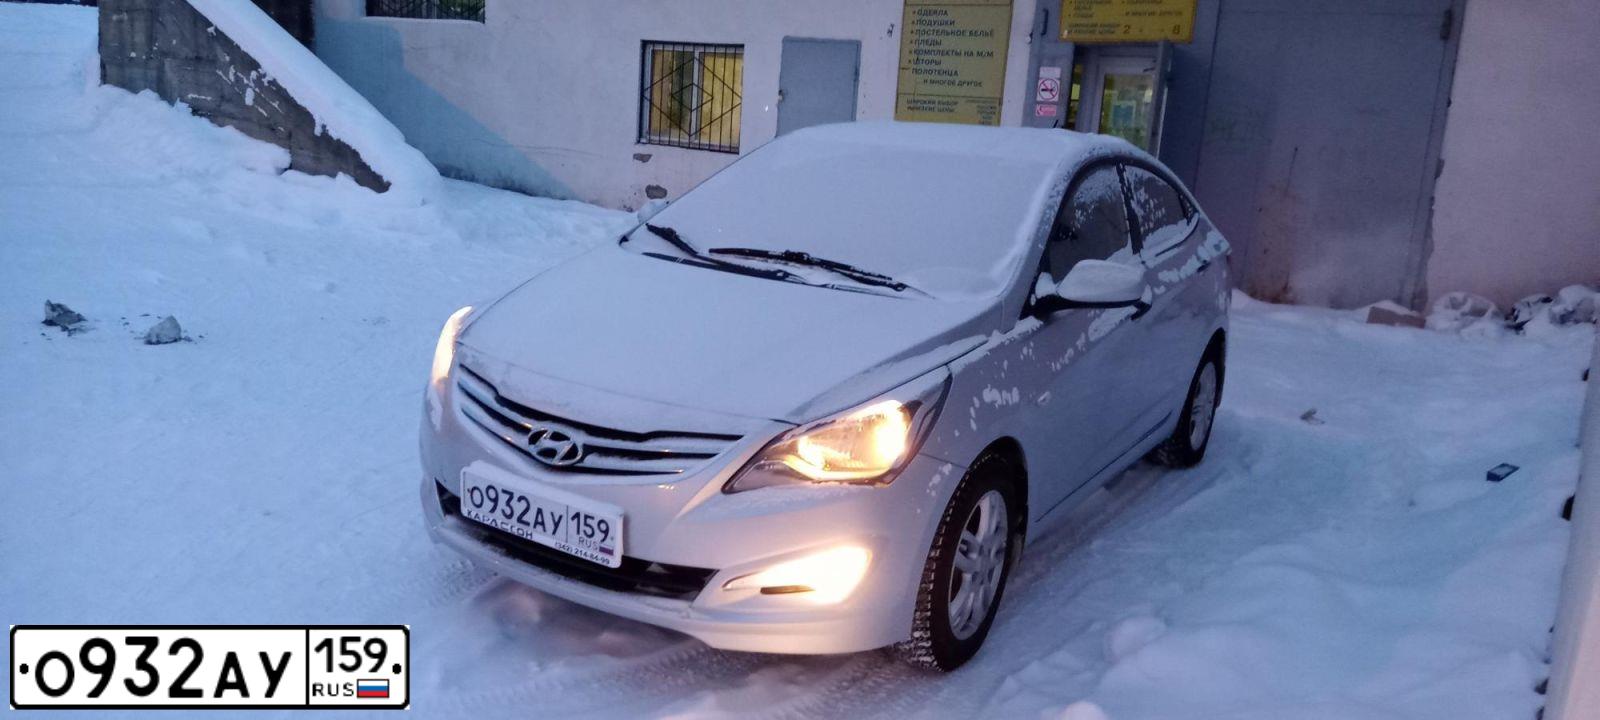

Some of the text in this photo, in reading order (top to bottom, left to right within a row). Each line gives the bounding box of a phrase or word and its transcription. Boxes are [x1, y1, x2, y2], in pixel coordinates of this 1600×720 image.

[917, 9, 948, 17] ОДЕЯЛА
[916, 19, 955, 28] ПОДУШКИ
[915, 28, 966, 36] ПОСТЕЛЬНОЕ
[914, 39, 942, 47] ПЛЕДЫ
[913, 49, 962, 57] КОМПЛЕКТЫ
[976, 50, 994, 58] М/М
[912, 57, 942, 66] ШТОРЫ
[911, 68, 959, 77] ПОЛОТЕНЦА
[570, 511, 610, 543] 159
[578, 536, 599, 551] RUS
